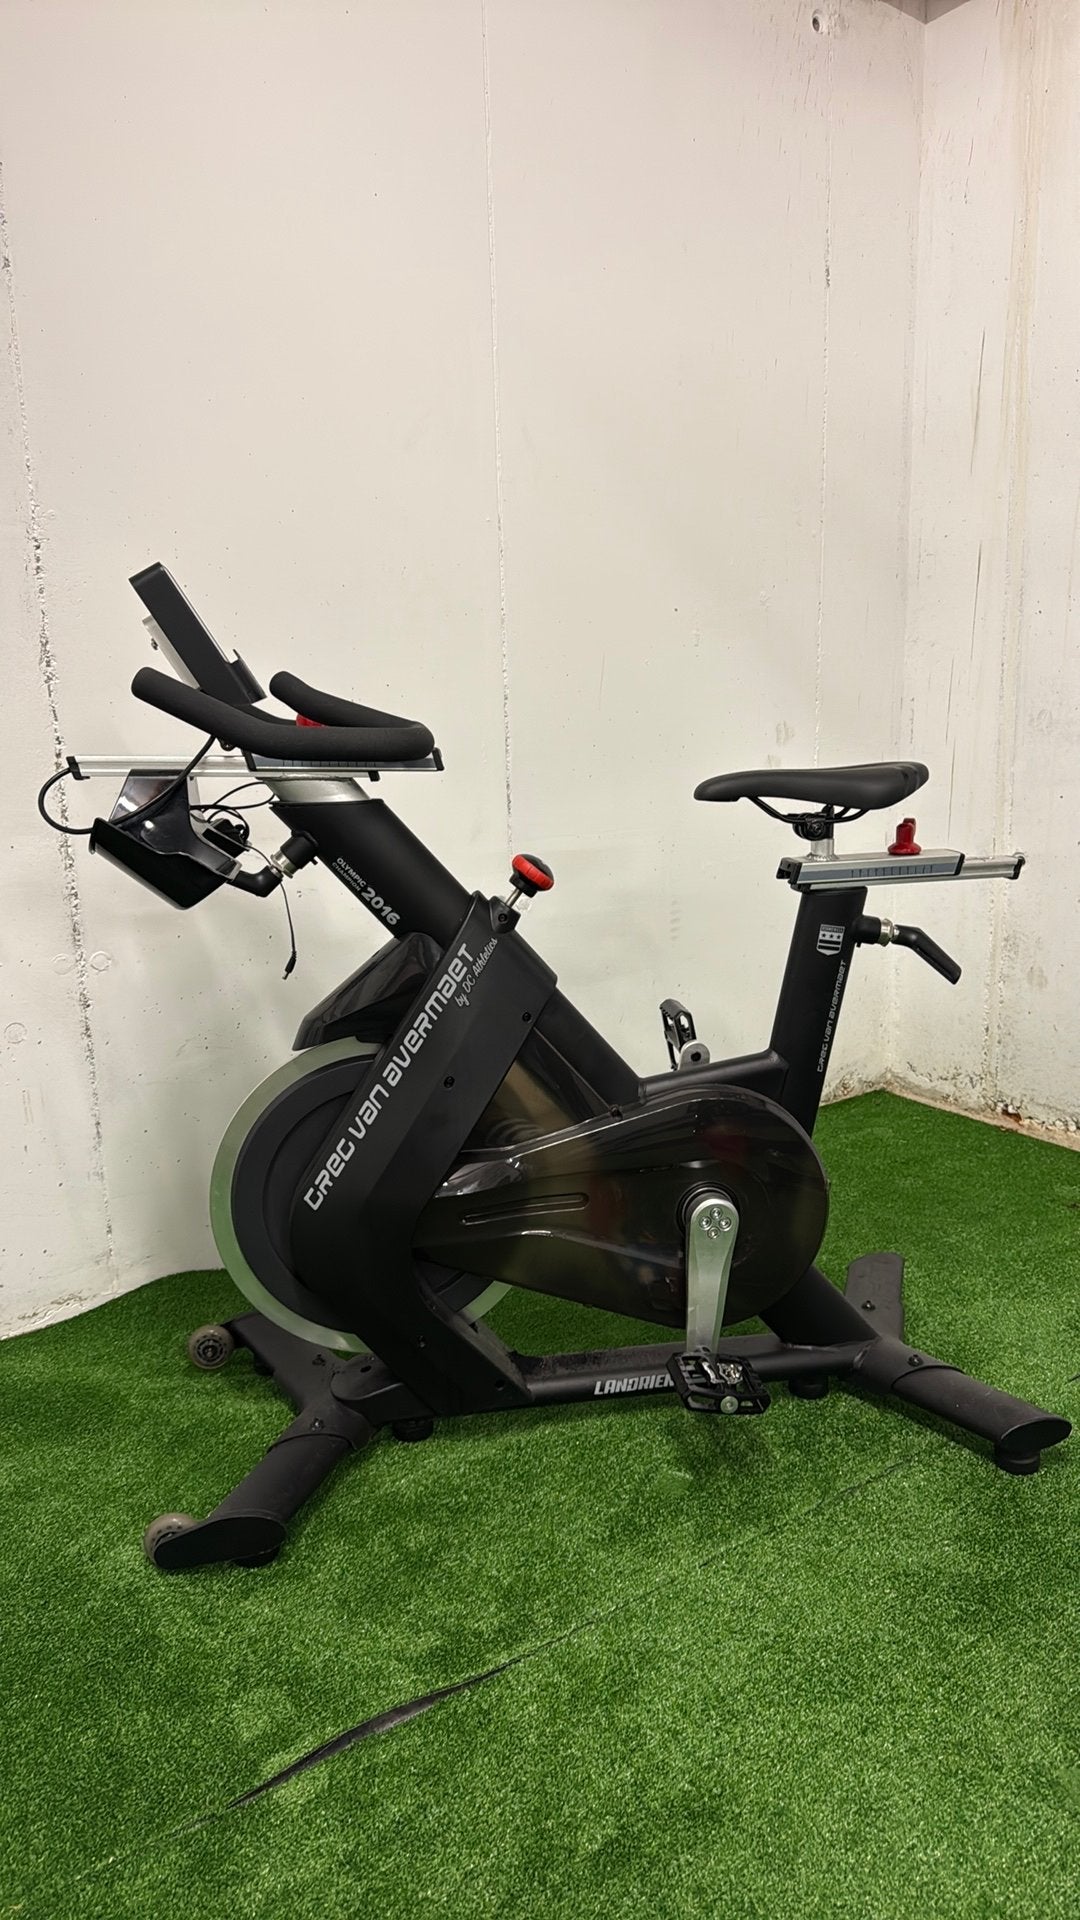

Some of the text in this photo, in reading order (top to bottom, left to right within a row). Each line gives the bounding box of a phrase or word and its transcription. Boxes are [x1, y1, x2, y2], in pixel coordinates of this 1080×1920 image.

[332, 862, 361, 891] CHAMPION
[337, 858, 366, 887] OLYMPIC
[361, 887, 400, 925] 2016
[454, 938, 498, 1007] by DC Athletics
[348, 1083, 390, 1140] VAN
